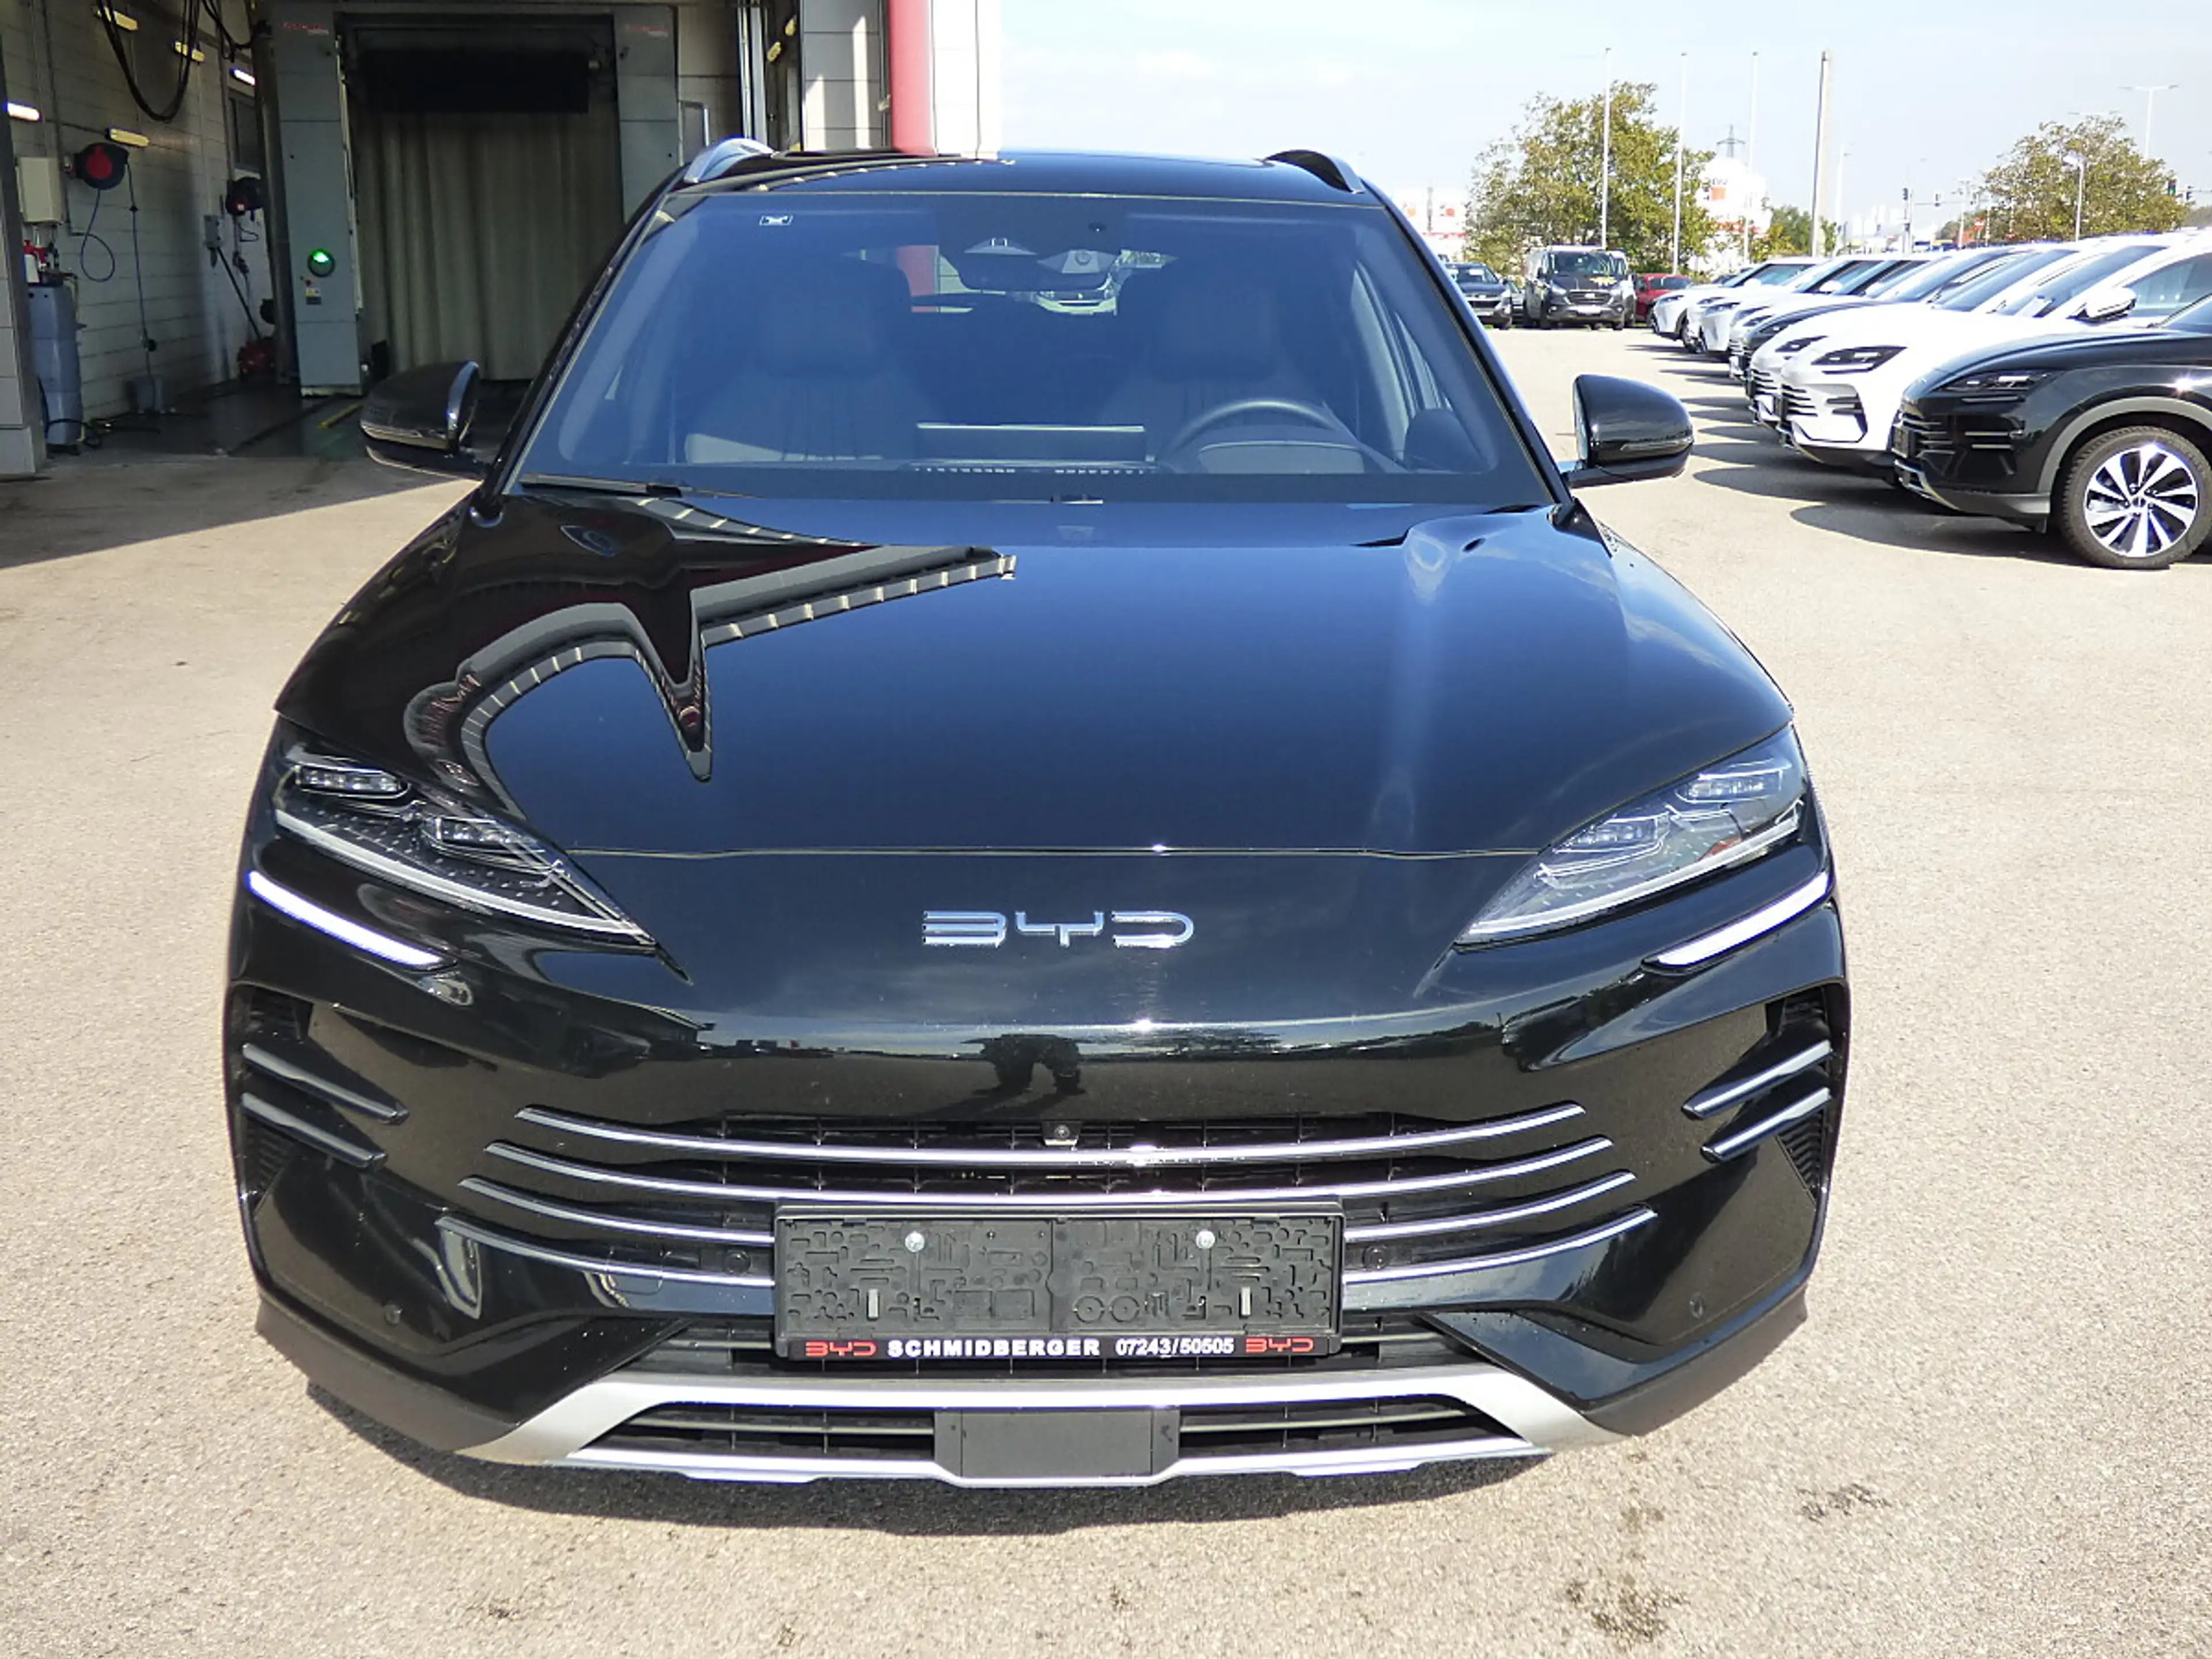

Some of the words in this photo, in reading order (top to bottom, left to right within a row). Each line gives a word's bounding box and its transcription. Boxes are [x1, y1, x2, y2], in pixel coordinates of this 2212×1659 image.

[922, 910, 1195, 948] BYD
[805, 1341, 877, 1357] BYD
[887, 1339, 1101, 1358] SCHMIDBERGER
[1115, 1337, 1235, 1357] 07243/50505
[1245, 1337, 1314, 1353] BYD
